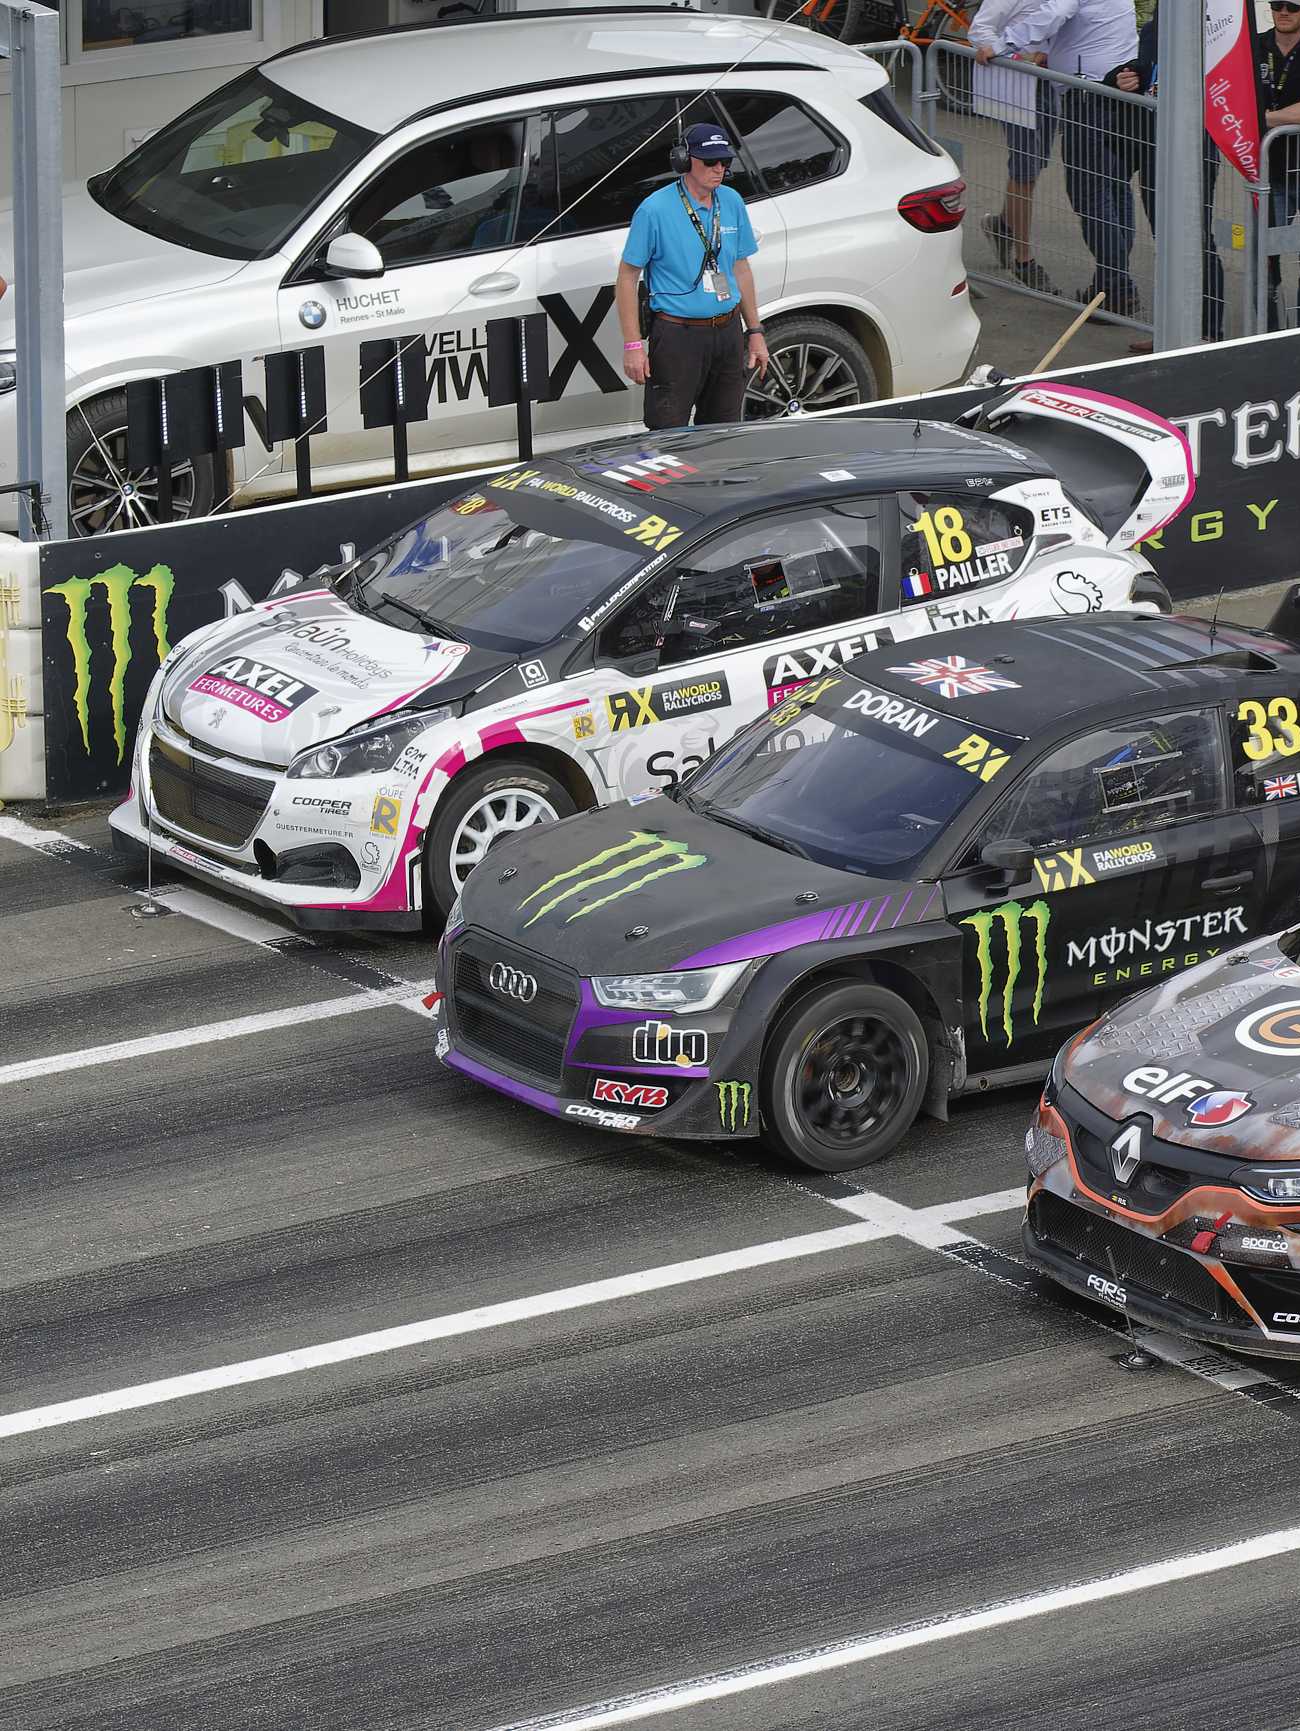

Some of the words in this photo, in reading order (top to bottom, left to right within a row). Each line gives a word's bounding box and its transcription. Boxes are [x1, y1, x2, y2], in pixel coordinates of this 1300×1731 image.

[335, 288, 401, 312] HUCHET
[385, 307, 406, 317] Malo
[572, 490, 637, 524] RALLYCROSS
[1041, 506, 1072, 522] ETS
[912, 506, 973, 567] 18
[935, 552, 1014, 591] PAILLER
[259, 610, 351, 652] Salaün
[210, 657, 306, 708] AXEL
[194, 677, 284, 722] FERMETURES
[663, 691, 723, 712] RALLYCROSS
[842, 688, 940, 738] DORAN
[292, 796, 353, 810] COOPER
[319, 806, 351, 816] TIRES
[1096, 850, 1157, 872] RALLYCROSS
[1065, 905, 1249, 968] MONSTER
[1093, 947, 1222, 986] ENERGY
[592, 1078, 669, 1108] KYB
[1121, 1065, 1217, 1106] elf
[565, 1104, 642, 1125] COOPER
[598, 1117, 638, 1131] TIRES
[1241, 1235, 1289, 1251] sparco
